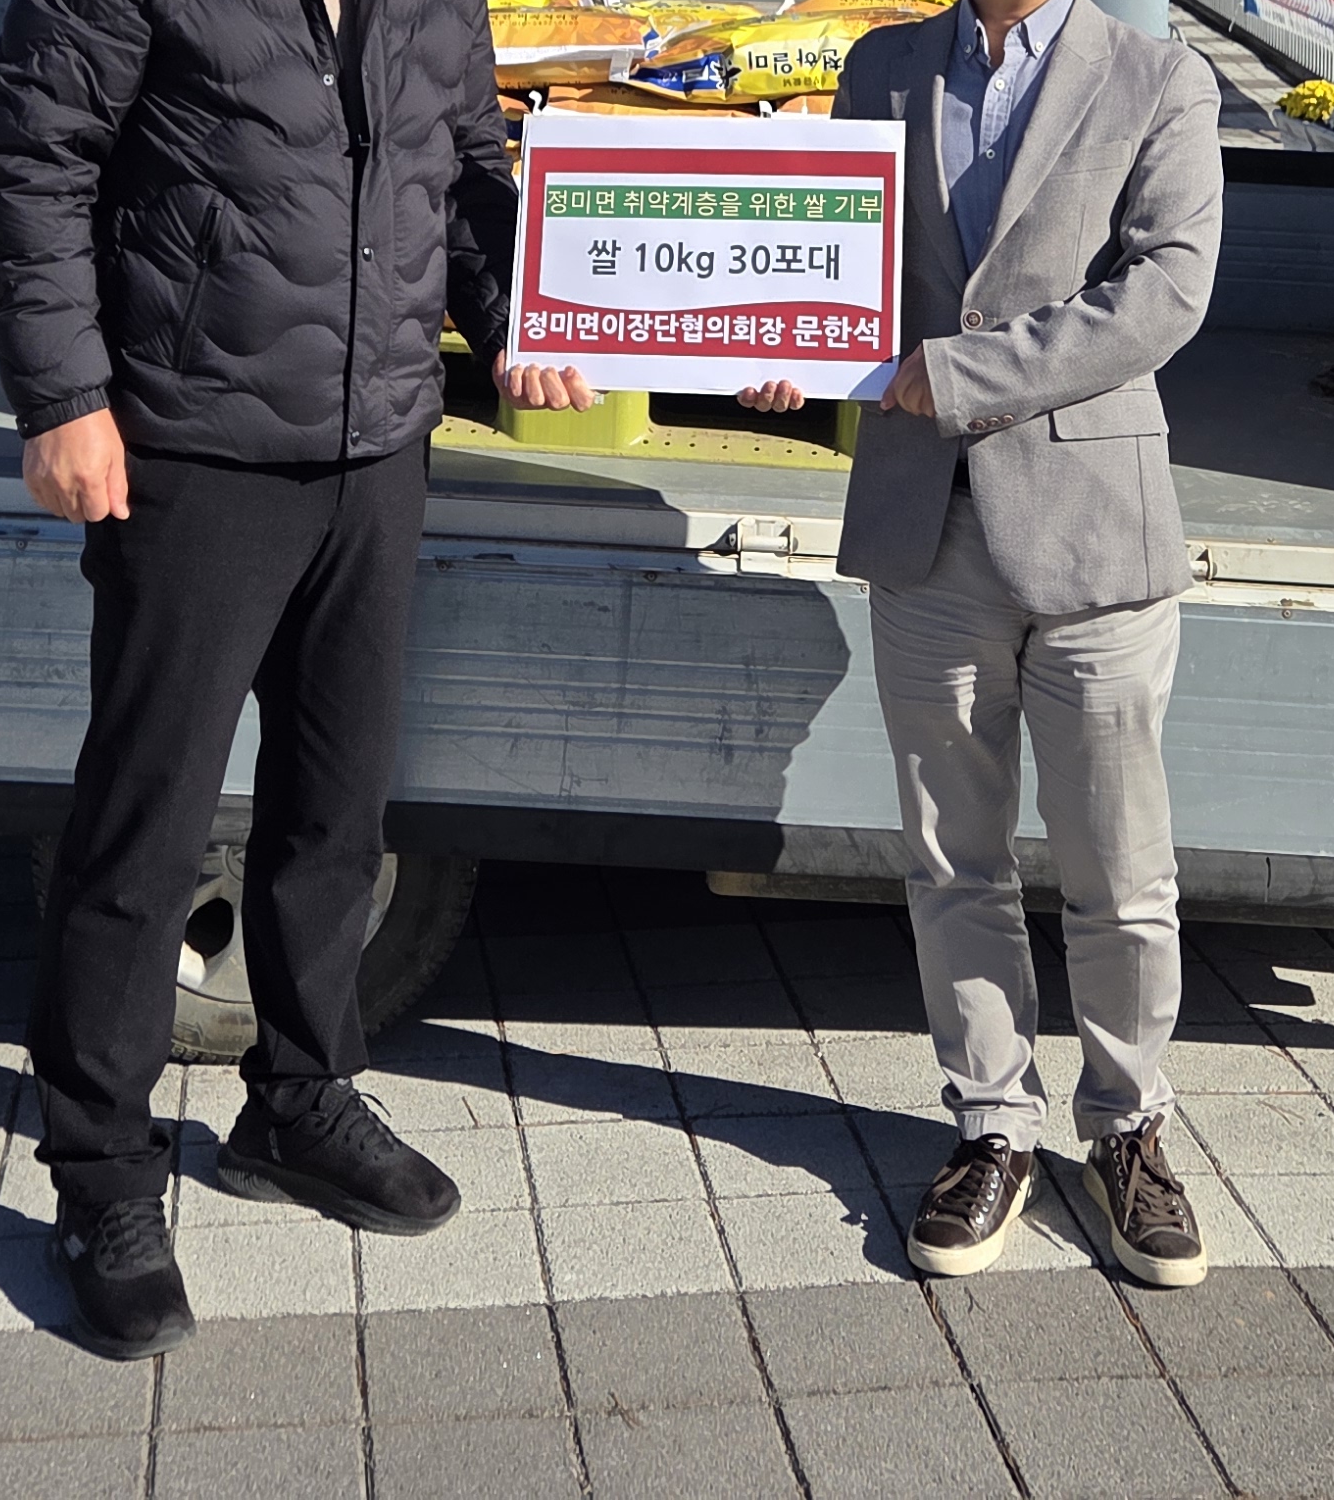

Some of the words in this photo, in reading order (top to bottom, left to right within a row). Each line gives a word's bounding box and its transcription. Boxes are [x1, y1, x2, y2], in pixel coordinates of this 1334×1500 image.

[747, 48, 843, 76] 천하일미
[546, 188, 616, 216] 정미면
[623, 190, 742, 217] 취약계층을
[749, 192, 797, 218] 위한
[803, 193, 827, 219] 쌀
[834, 194, 882, 220] 기부
[587, 239, 622, 276] 쌀
[635, 241, 715, 279] 10kg
[728, 244, 841, 281] 30포대
[523, 309, 786, 348] 정미면이장단협의회장
[792, 315, 881, 350] 문한석
